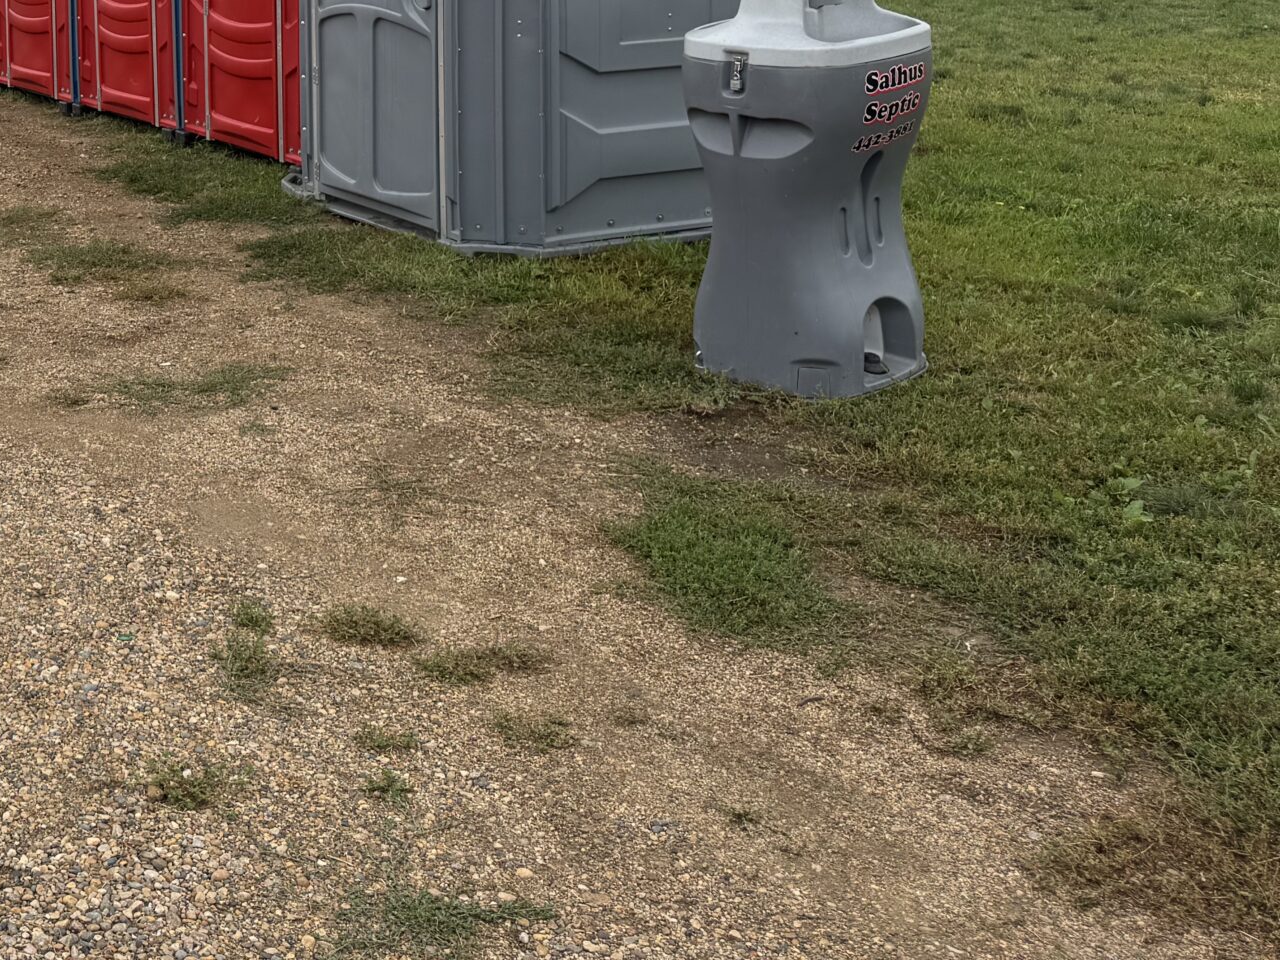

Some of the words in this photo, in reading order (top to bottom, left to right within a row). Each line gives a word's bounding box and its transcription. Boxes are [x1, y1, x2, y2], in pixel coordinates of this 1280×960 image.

[865, 62, 925, 96] Salhus
[863, 91, 921, 126] Septic
[851, 120, 915, 153] 442-3881
